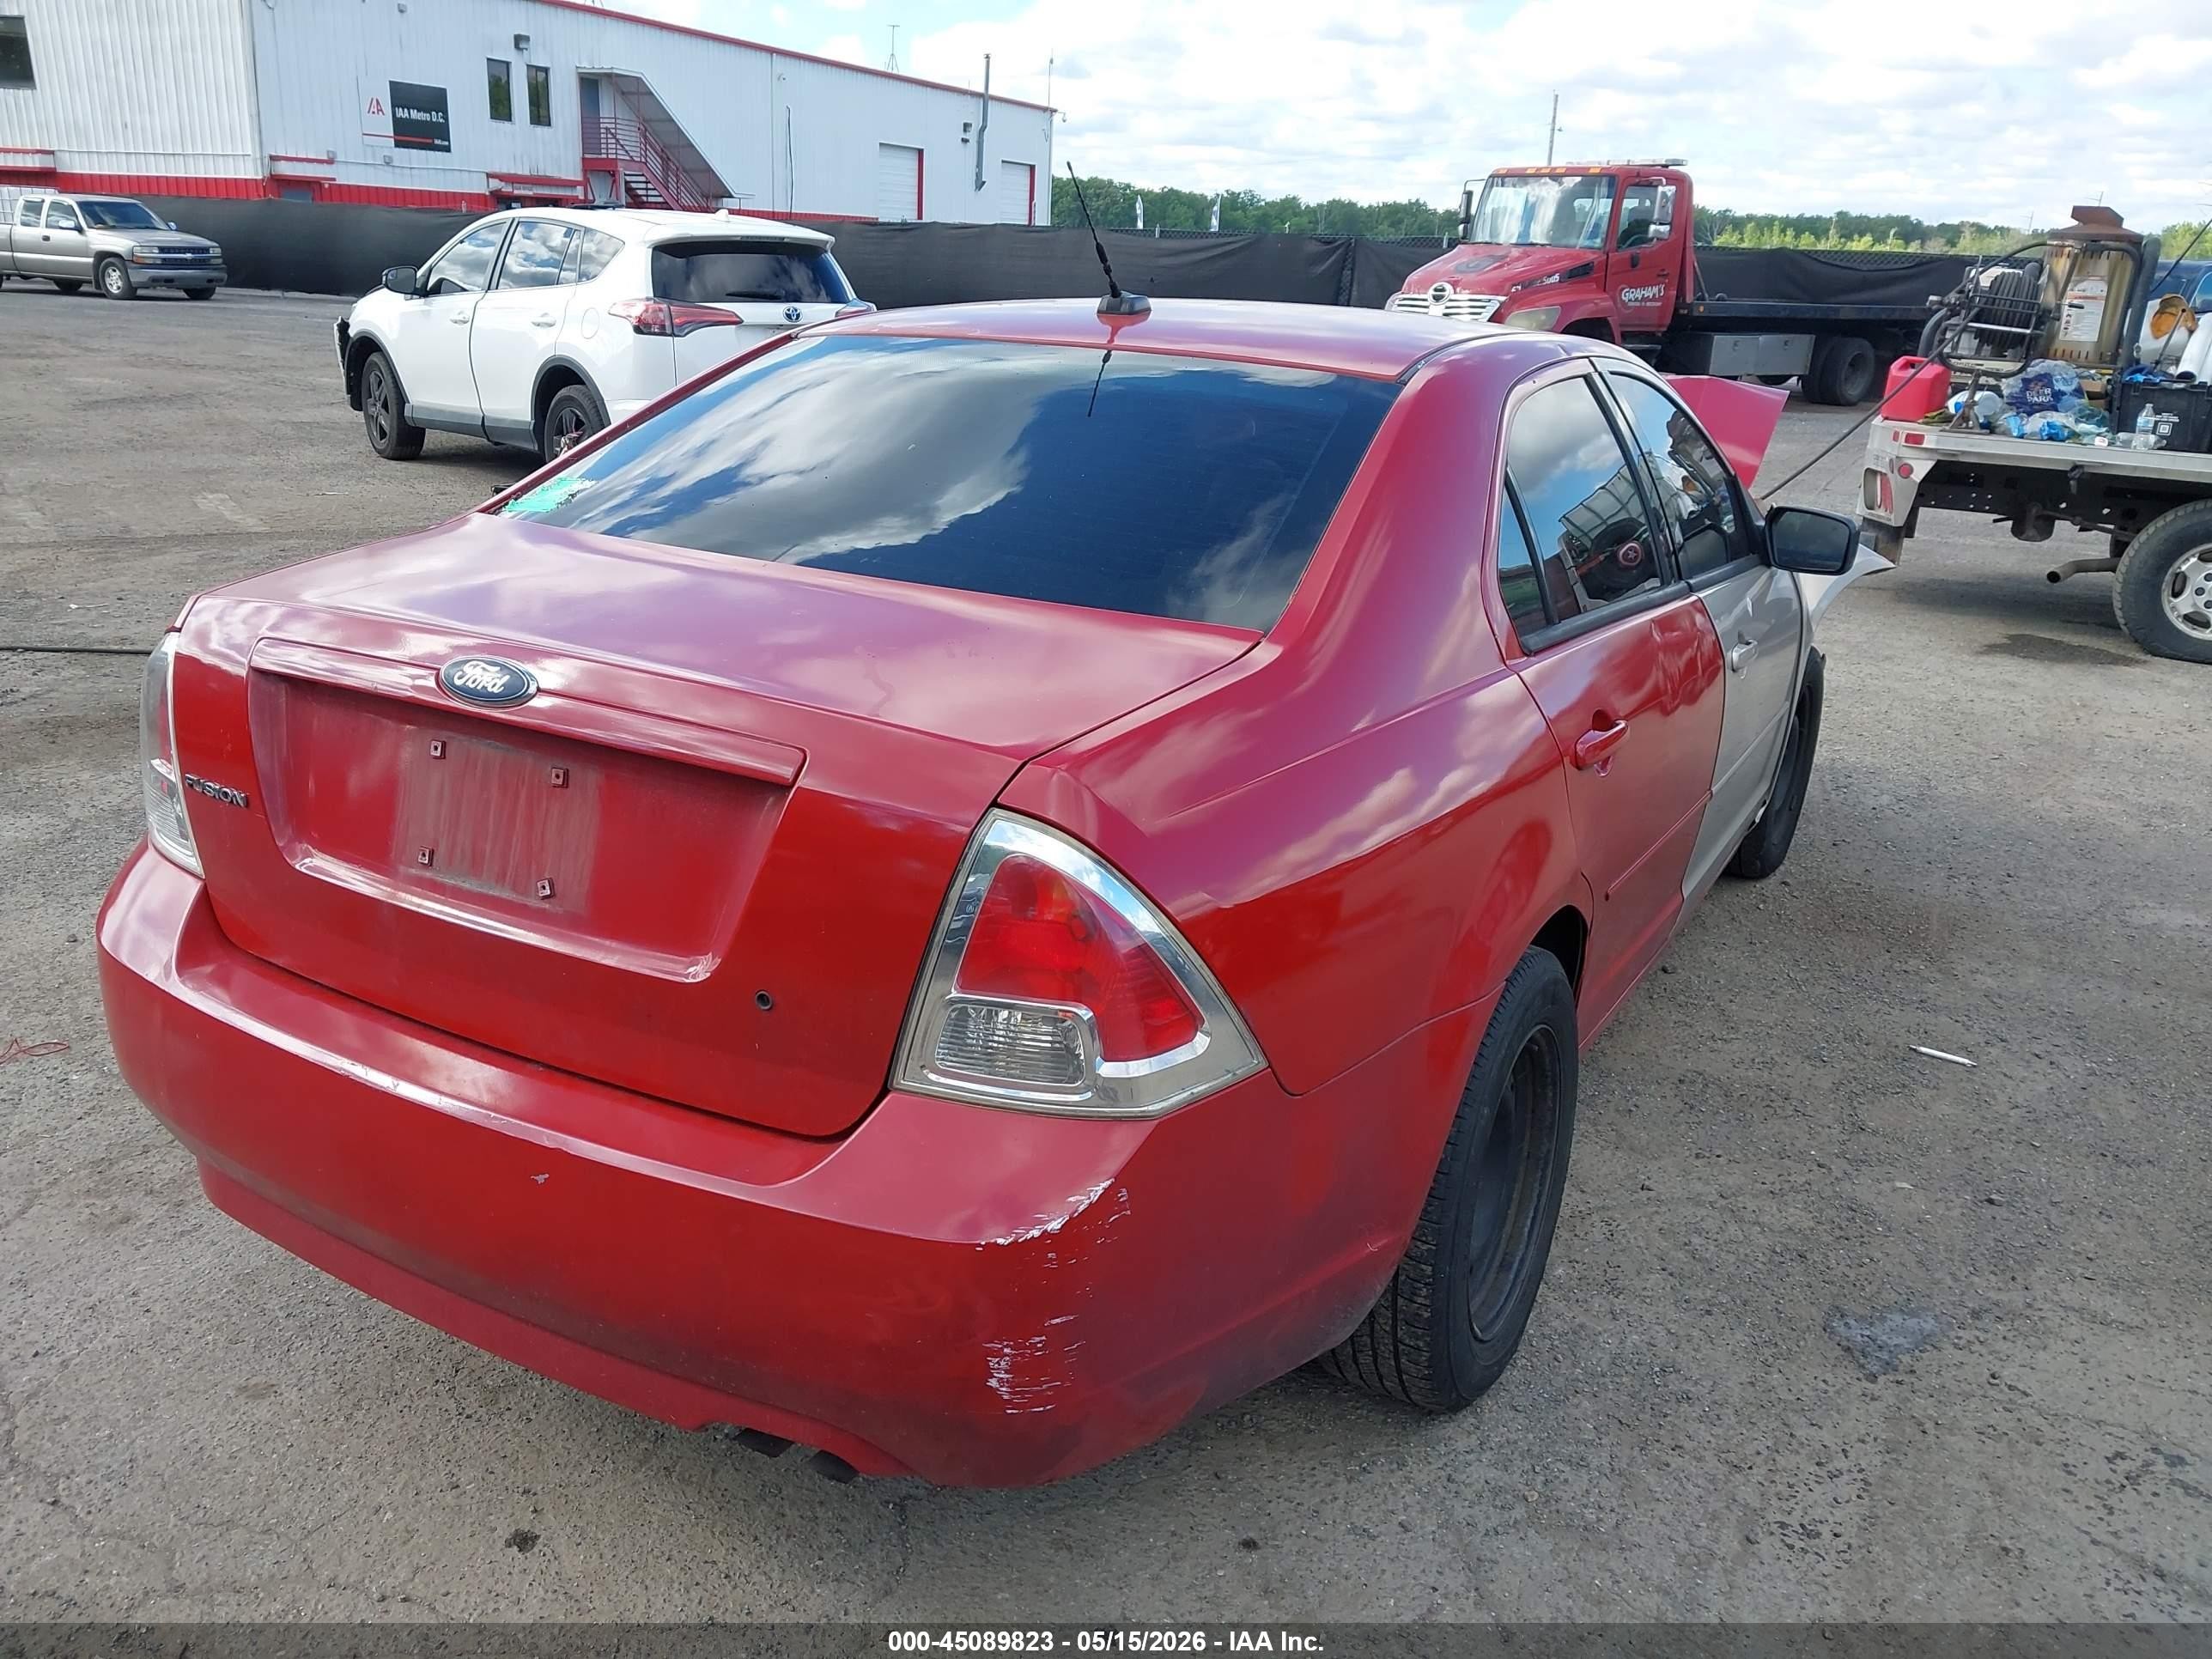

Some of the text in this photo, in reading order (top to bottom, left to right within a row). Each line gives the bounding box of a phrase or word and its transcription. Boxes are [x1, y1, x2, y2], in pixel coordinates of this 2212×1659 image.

[395, 106, 446, 123] IAA Metro D.C.
[1621, 283, 1665, 303] GRAHAM'S
[453, 660, 510, 694] Ford
[185, 773, 248, 809] FUSION
